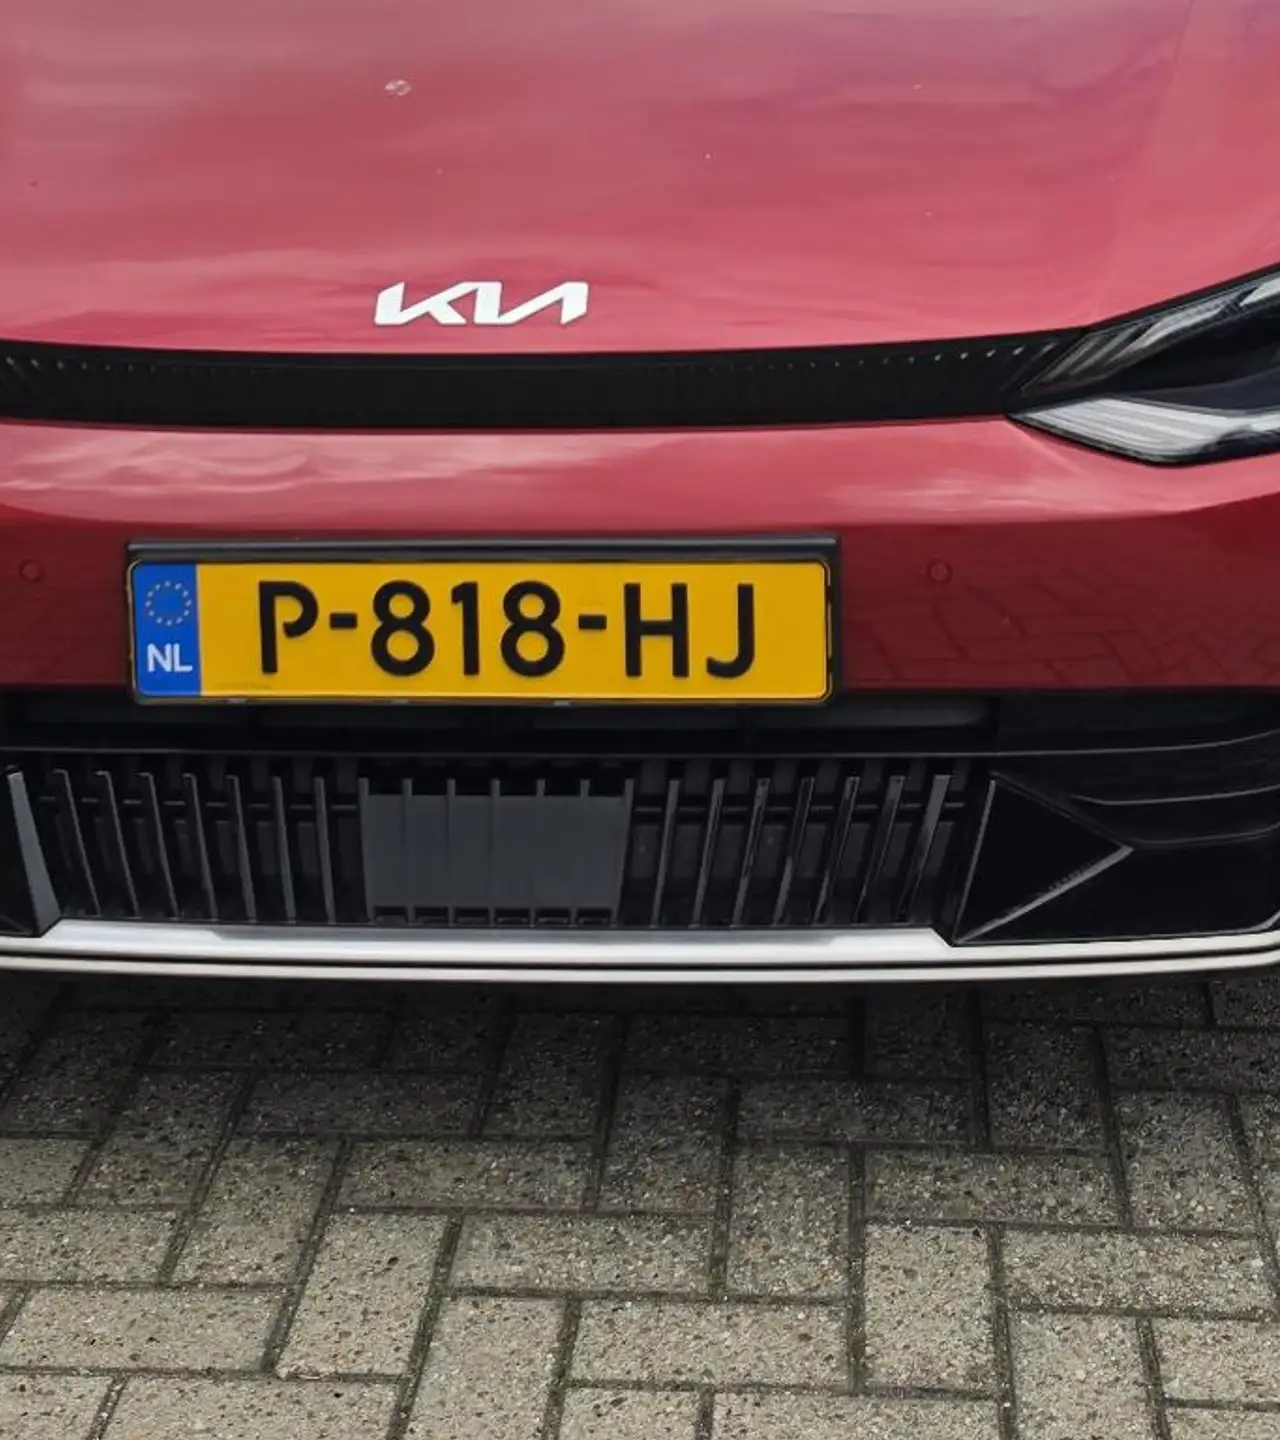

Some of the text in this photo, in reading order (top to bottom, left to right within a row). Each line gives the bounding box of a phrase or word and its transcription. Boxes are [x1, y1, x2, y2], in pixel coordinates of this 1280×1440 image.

[374, 280, 589, 326] KIA
[258, 580, 756, 679] P-818-HJ
[147, 643, 193, 674] NL
